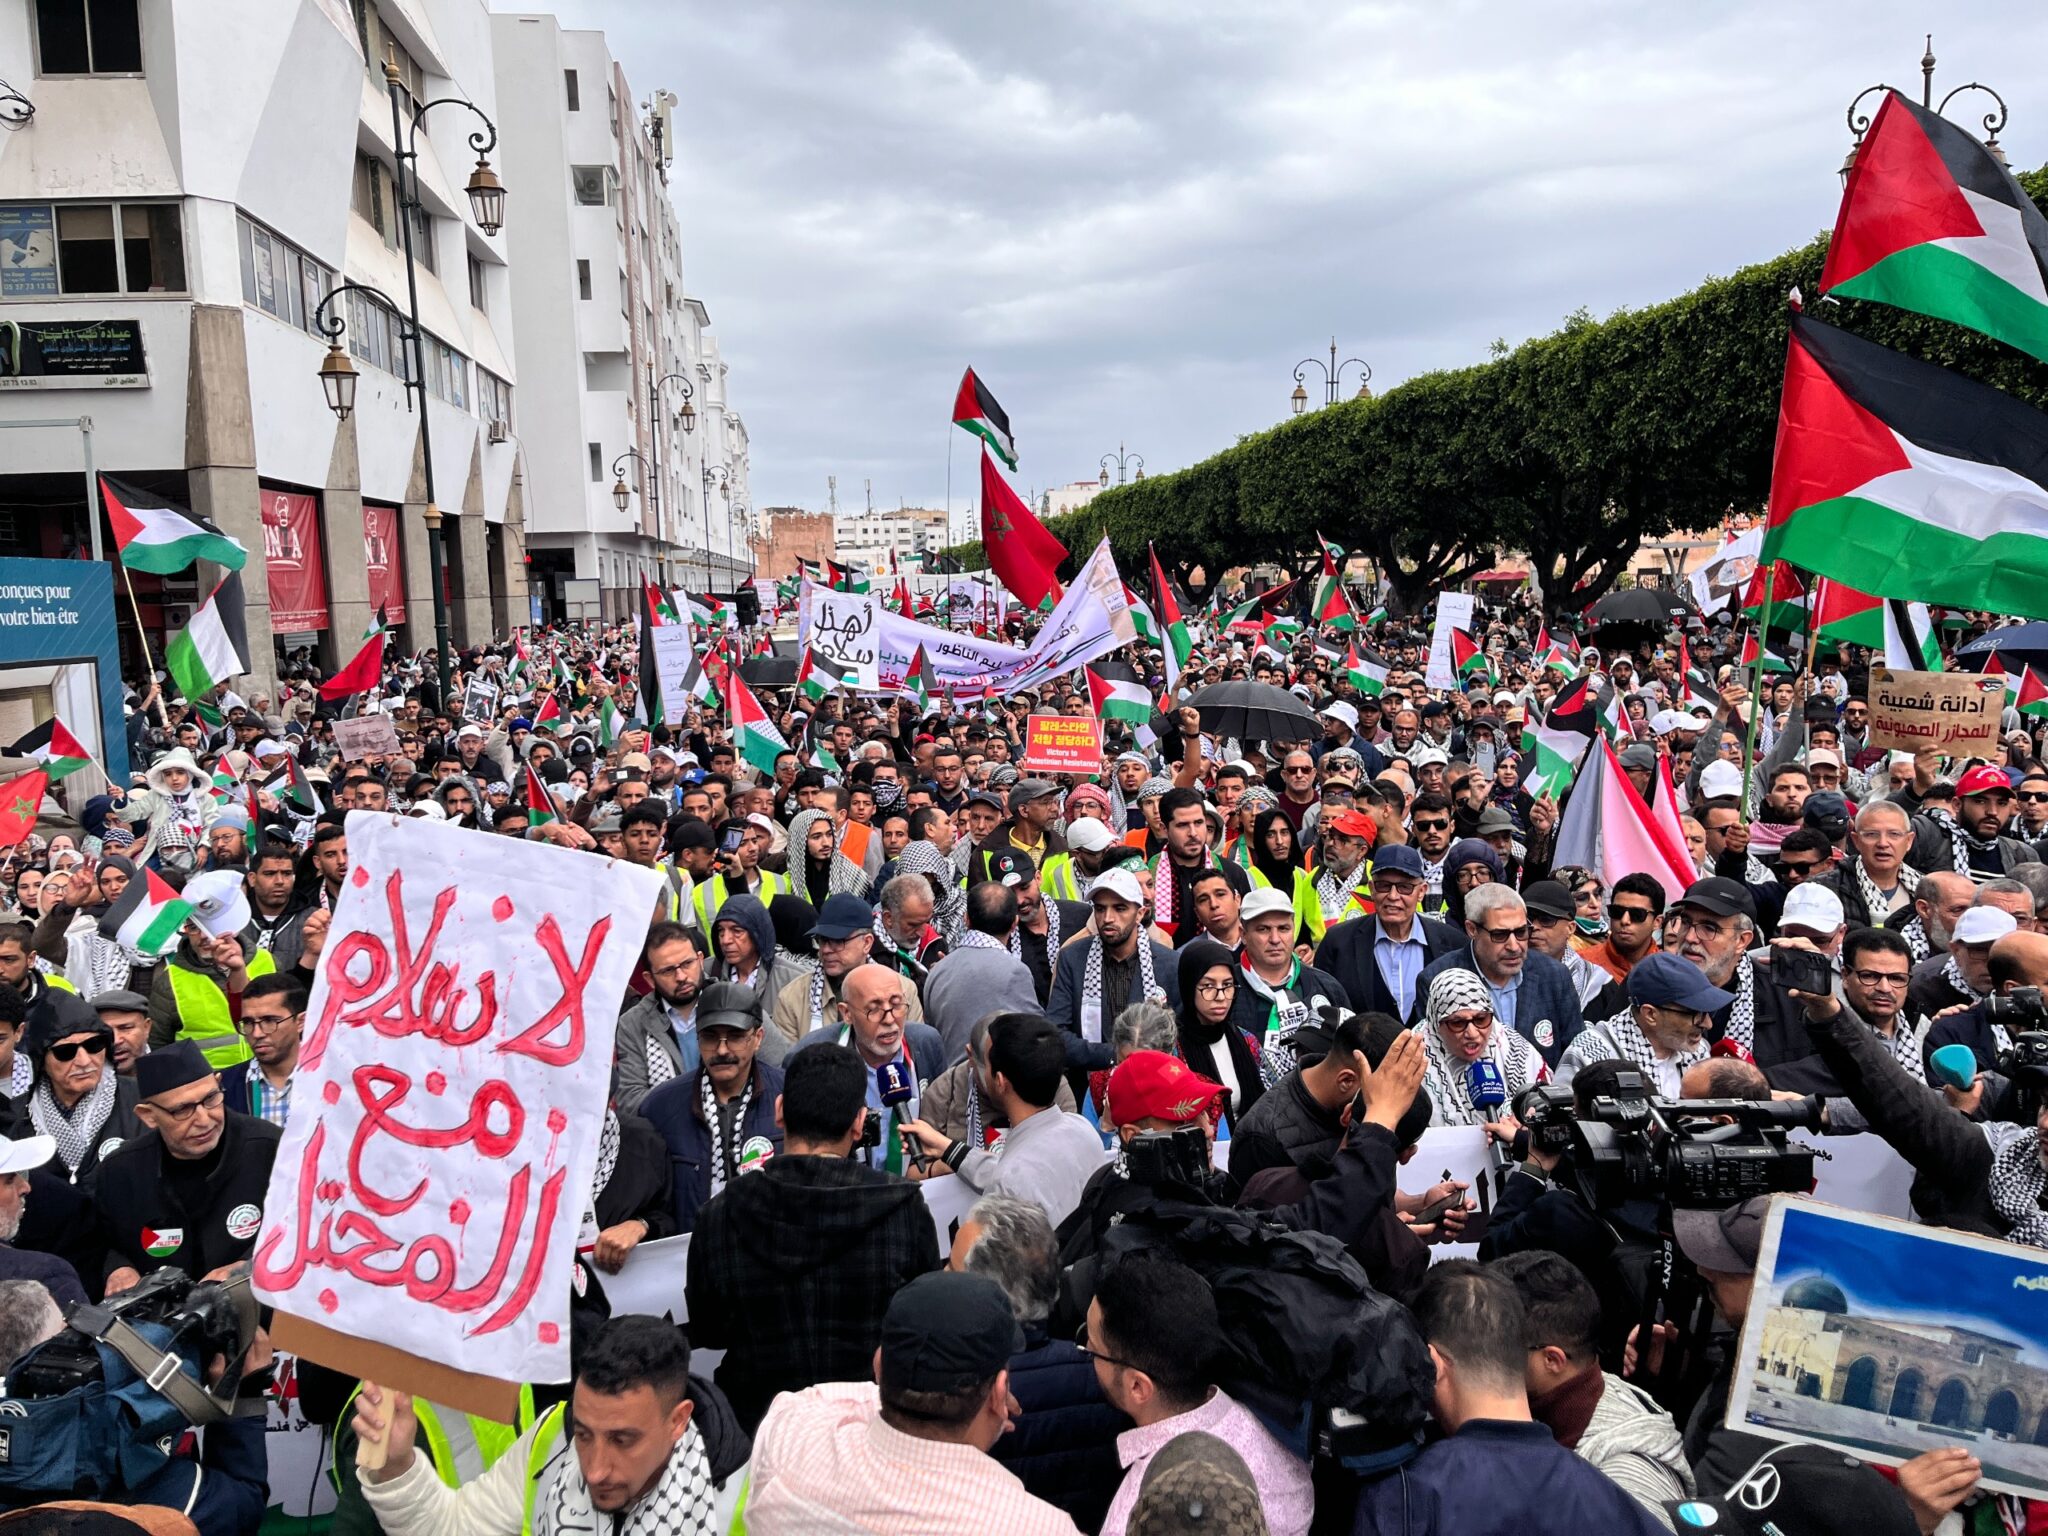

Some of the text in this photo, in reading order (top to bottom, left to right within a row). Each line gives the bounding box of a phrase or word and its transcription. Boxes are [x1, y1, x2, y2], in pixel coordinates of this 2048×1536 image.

[45, 586, 71, 604] pour
[0, 606, 79, 626] votre bien-être
[936, 642, 979, 662] الناظور
[1879, 690, 1986, 718] إدانة شعبية
[1040, 721, 1089, 733] 팔레스타인
[1875, 715, 1991, 743] للمجازر الصهيونية
[1033, 734, 1096, 747] 저항 정당하다
[1027, 757, 1098, 767] Palestinian Resistance
[297, 868, 498, 1072] سلام
[1279, 1005, 1305, 1021] REE
[348, 1064, 525, 1216] مع
[252, 1115, 567, 1340] المحتل
[1662, 1239, 1674, 1290] SONY
